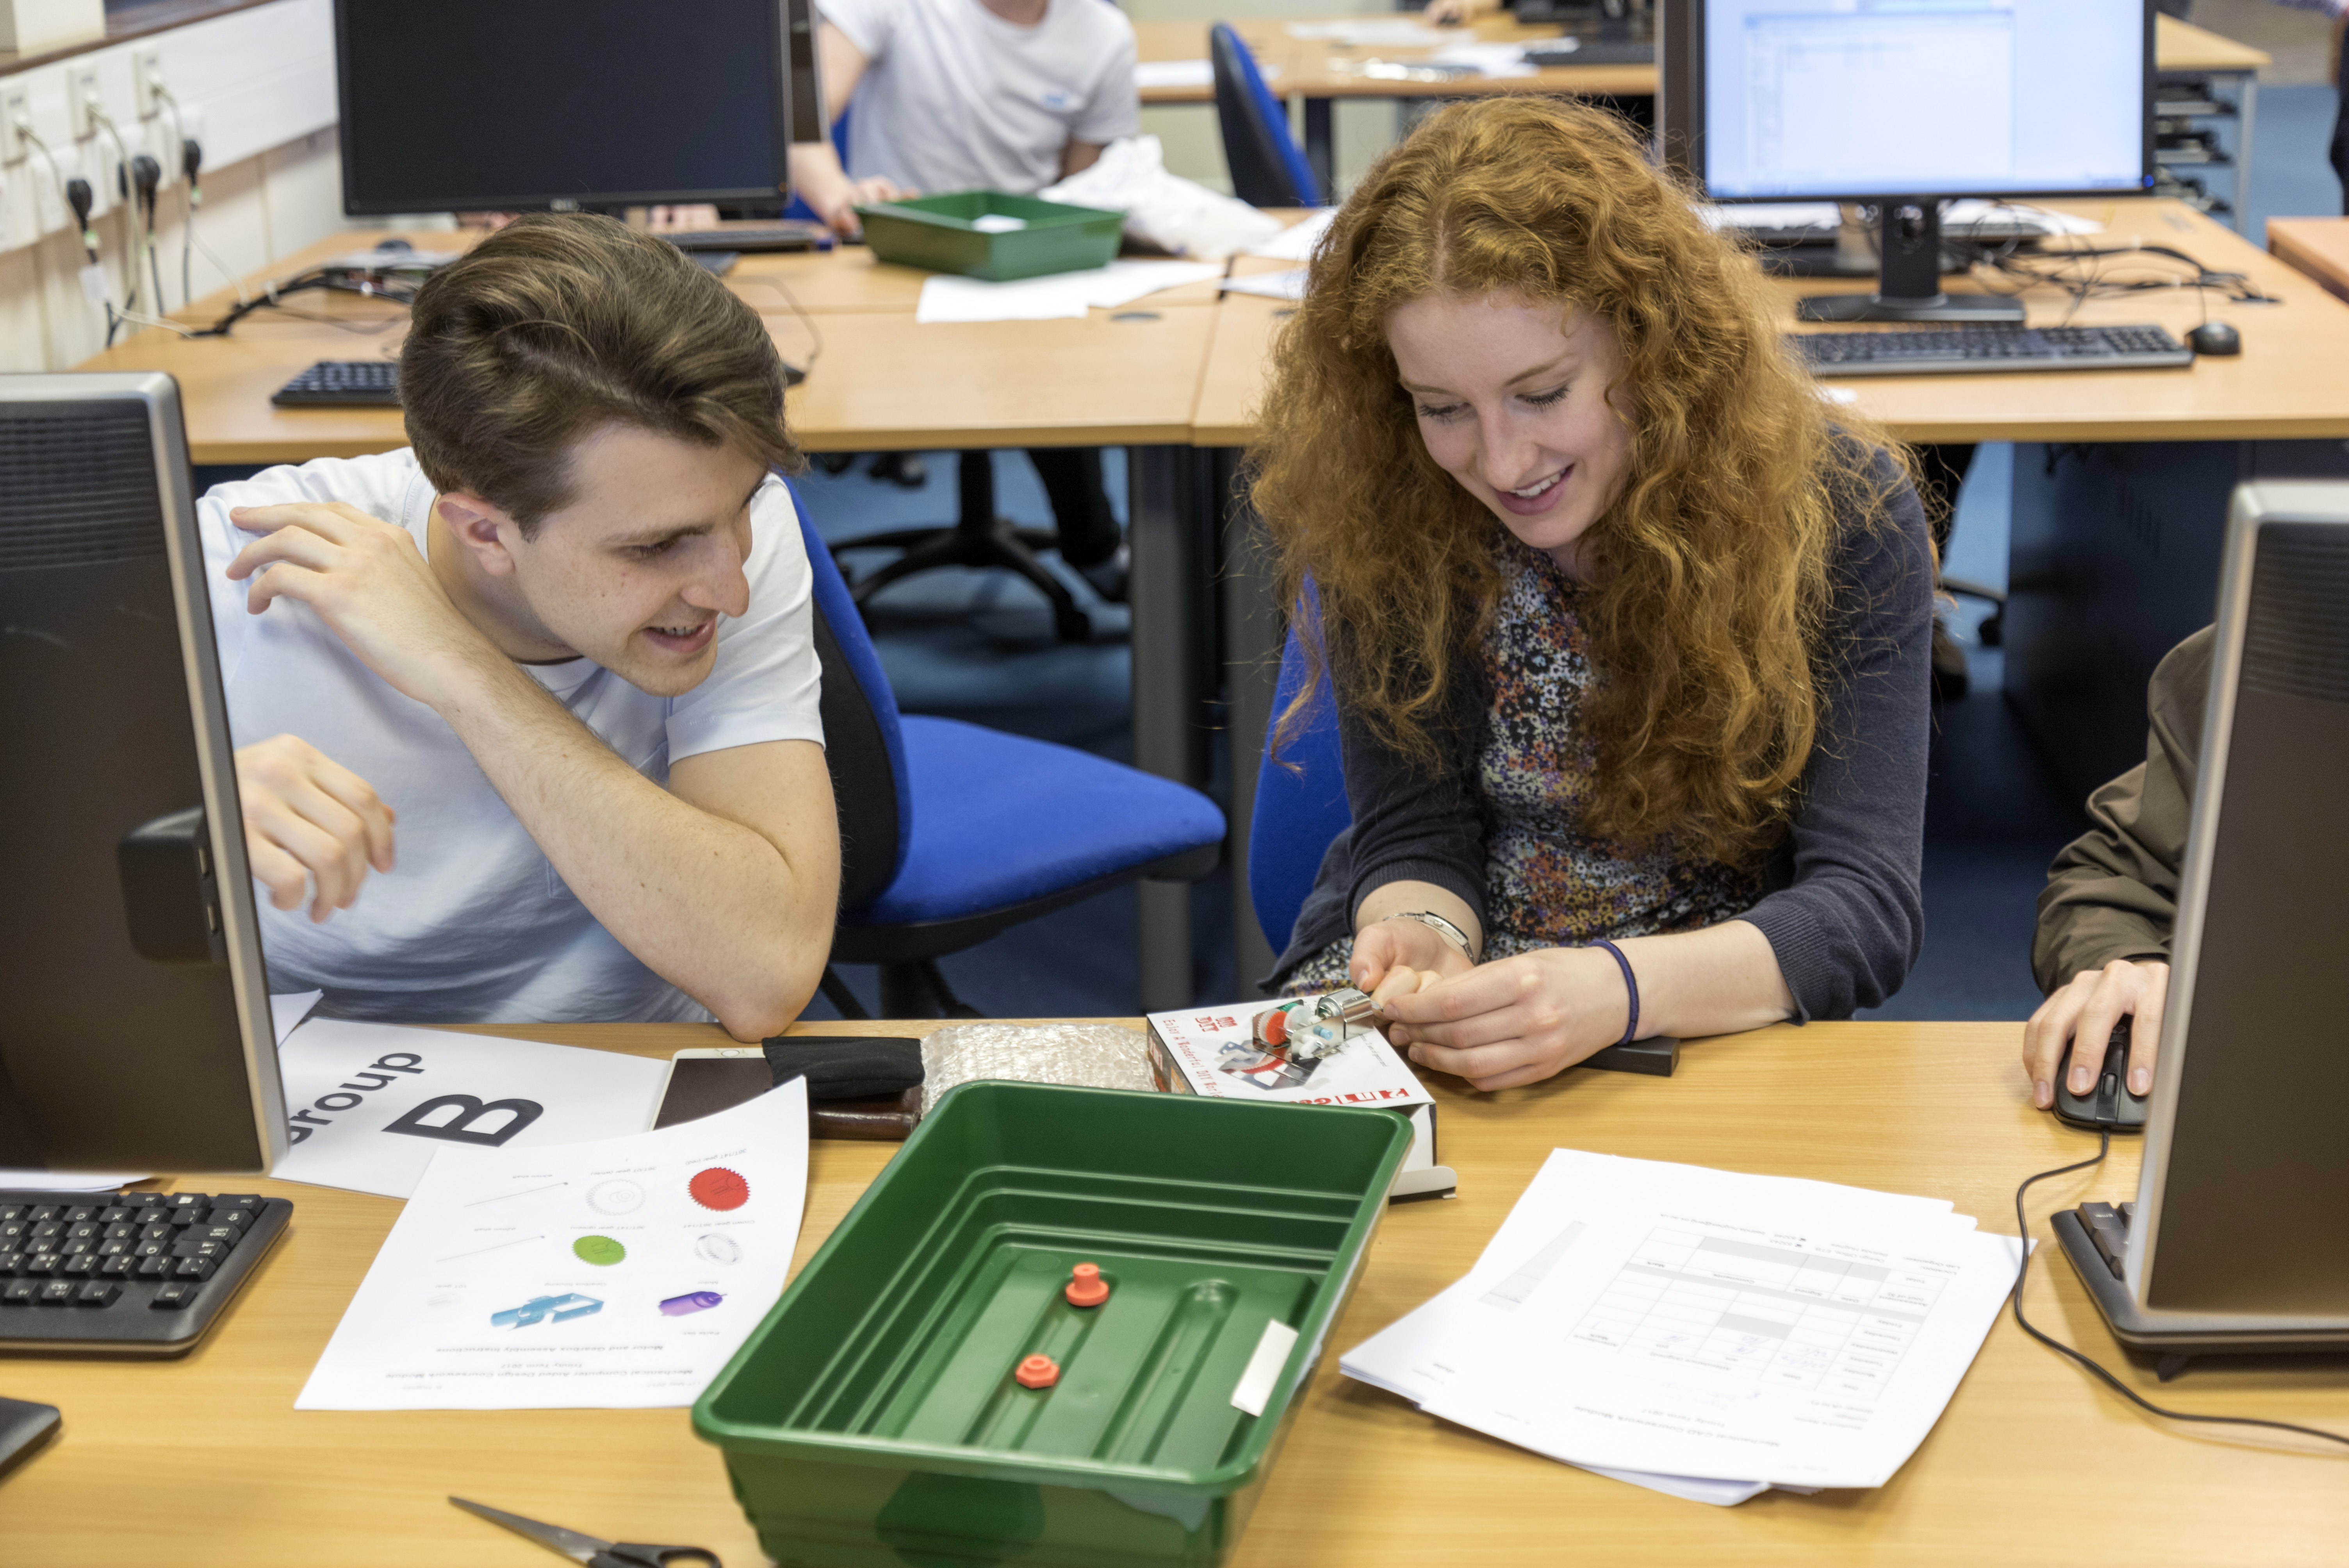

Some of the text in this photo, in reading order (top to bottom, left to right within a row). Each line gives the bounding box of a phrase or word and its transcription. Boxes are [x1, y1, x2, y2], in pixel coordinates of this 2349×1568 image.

[1163, 1019, 1180, 1034] Enjoy
[1178, 1042, 1205, 1068] Wonderful
[1196, 1070, 1213, 1080] DIY
[381, 1094, 544, 1147] B
[684, 1148, 747, 1166] 36T/14T gear (red)
[1647, 1261, 1666, 1269] Mark
[1859, 1255, 1885, 1263] Design
[1713, 1273, 1755, 1285] Comments
[1793, 1288, 1823, 1297] Signed
[1878, 1295, 1929, 1308] Assessment
[1877, 1319, 1903, 1329] Friday
[1573, 1334, 1618, 1348] Attendance
[1864, 1330, 1901, 1342] Thursday
[1850, 1342, 1898, 1356] Wednesday
[1685, 1358, 1731, 1372] Attendance
[1848, 1356, 1884, 1367] Tuesday
[1782, 1372, 1802, 1381] Date
[1843, 1368, 1876, 1379] Monday
[1842, 1383, 1859, 1392] Day
[1573, 1406, 1781, 1448] Mechanical CAD Coursework Module
